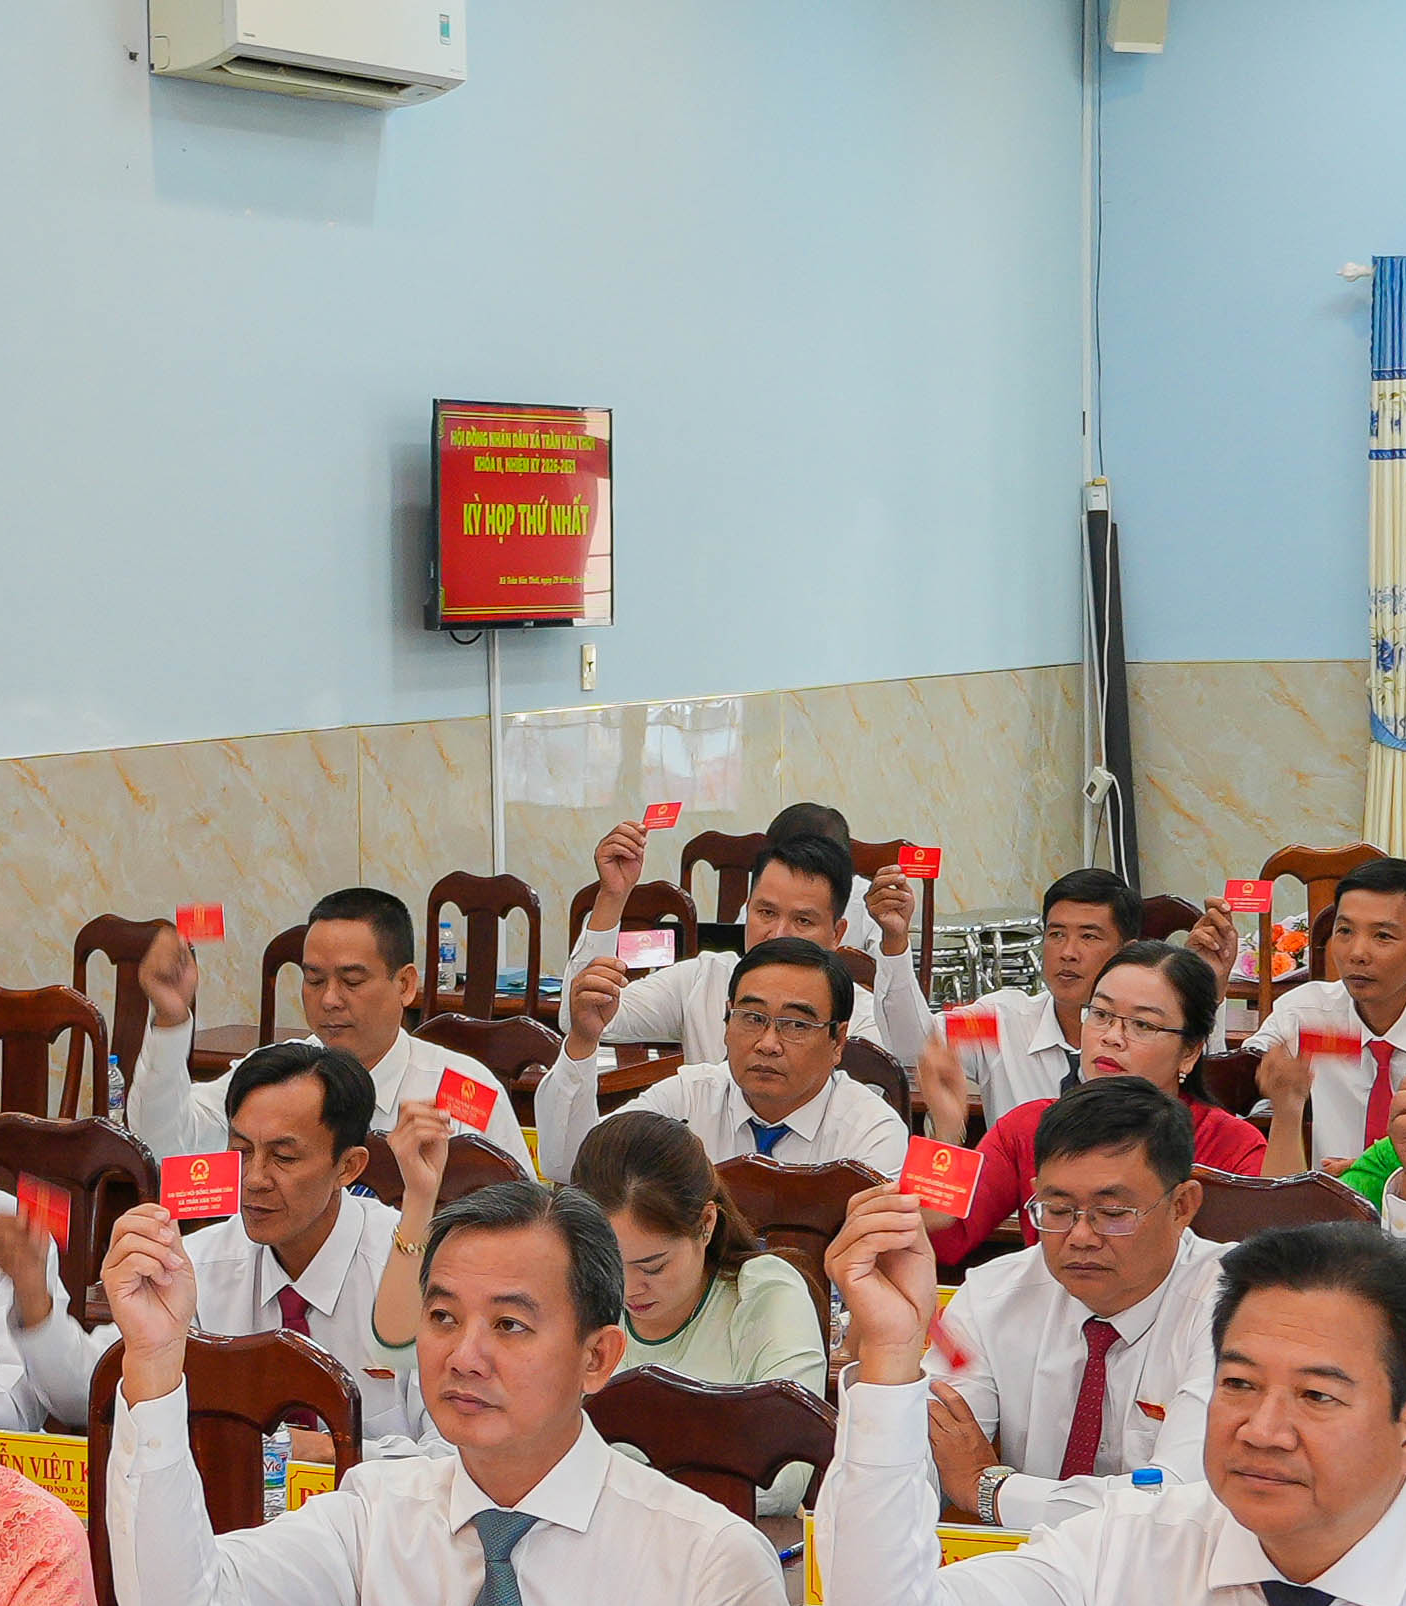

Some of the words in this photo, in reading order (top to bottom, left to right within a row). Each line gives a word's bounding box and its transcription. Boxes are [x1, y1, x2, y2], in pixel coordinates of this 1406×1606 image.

[463, 493, 482, 535] KỲ
[485, 504, 516, 544] HỌP
[517, 495, 549, 535] THỨ
[550, 493, 590, 535] NHẤT
[29, 1452, 74, 1484] VIỆT
